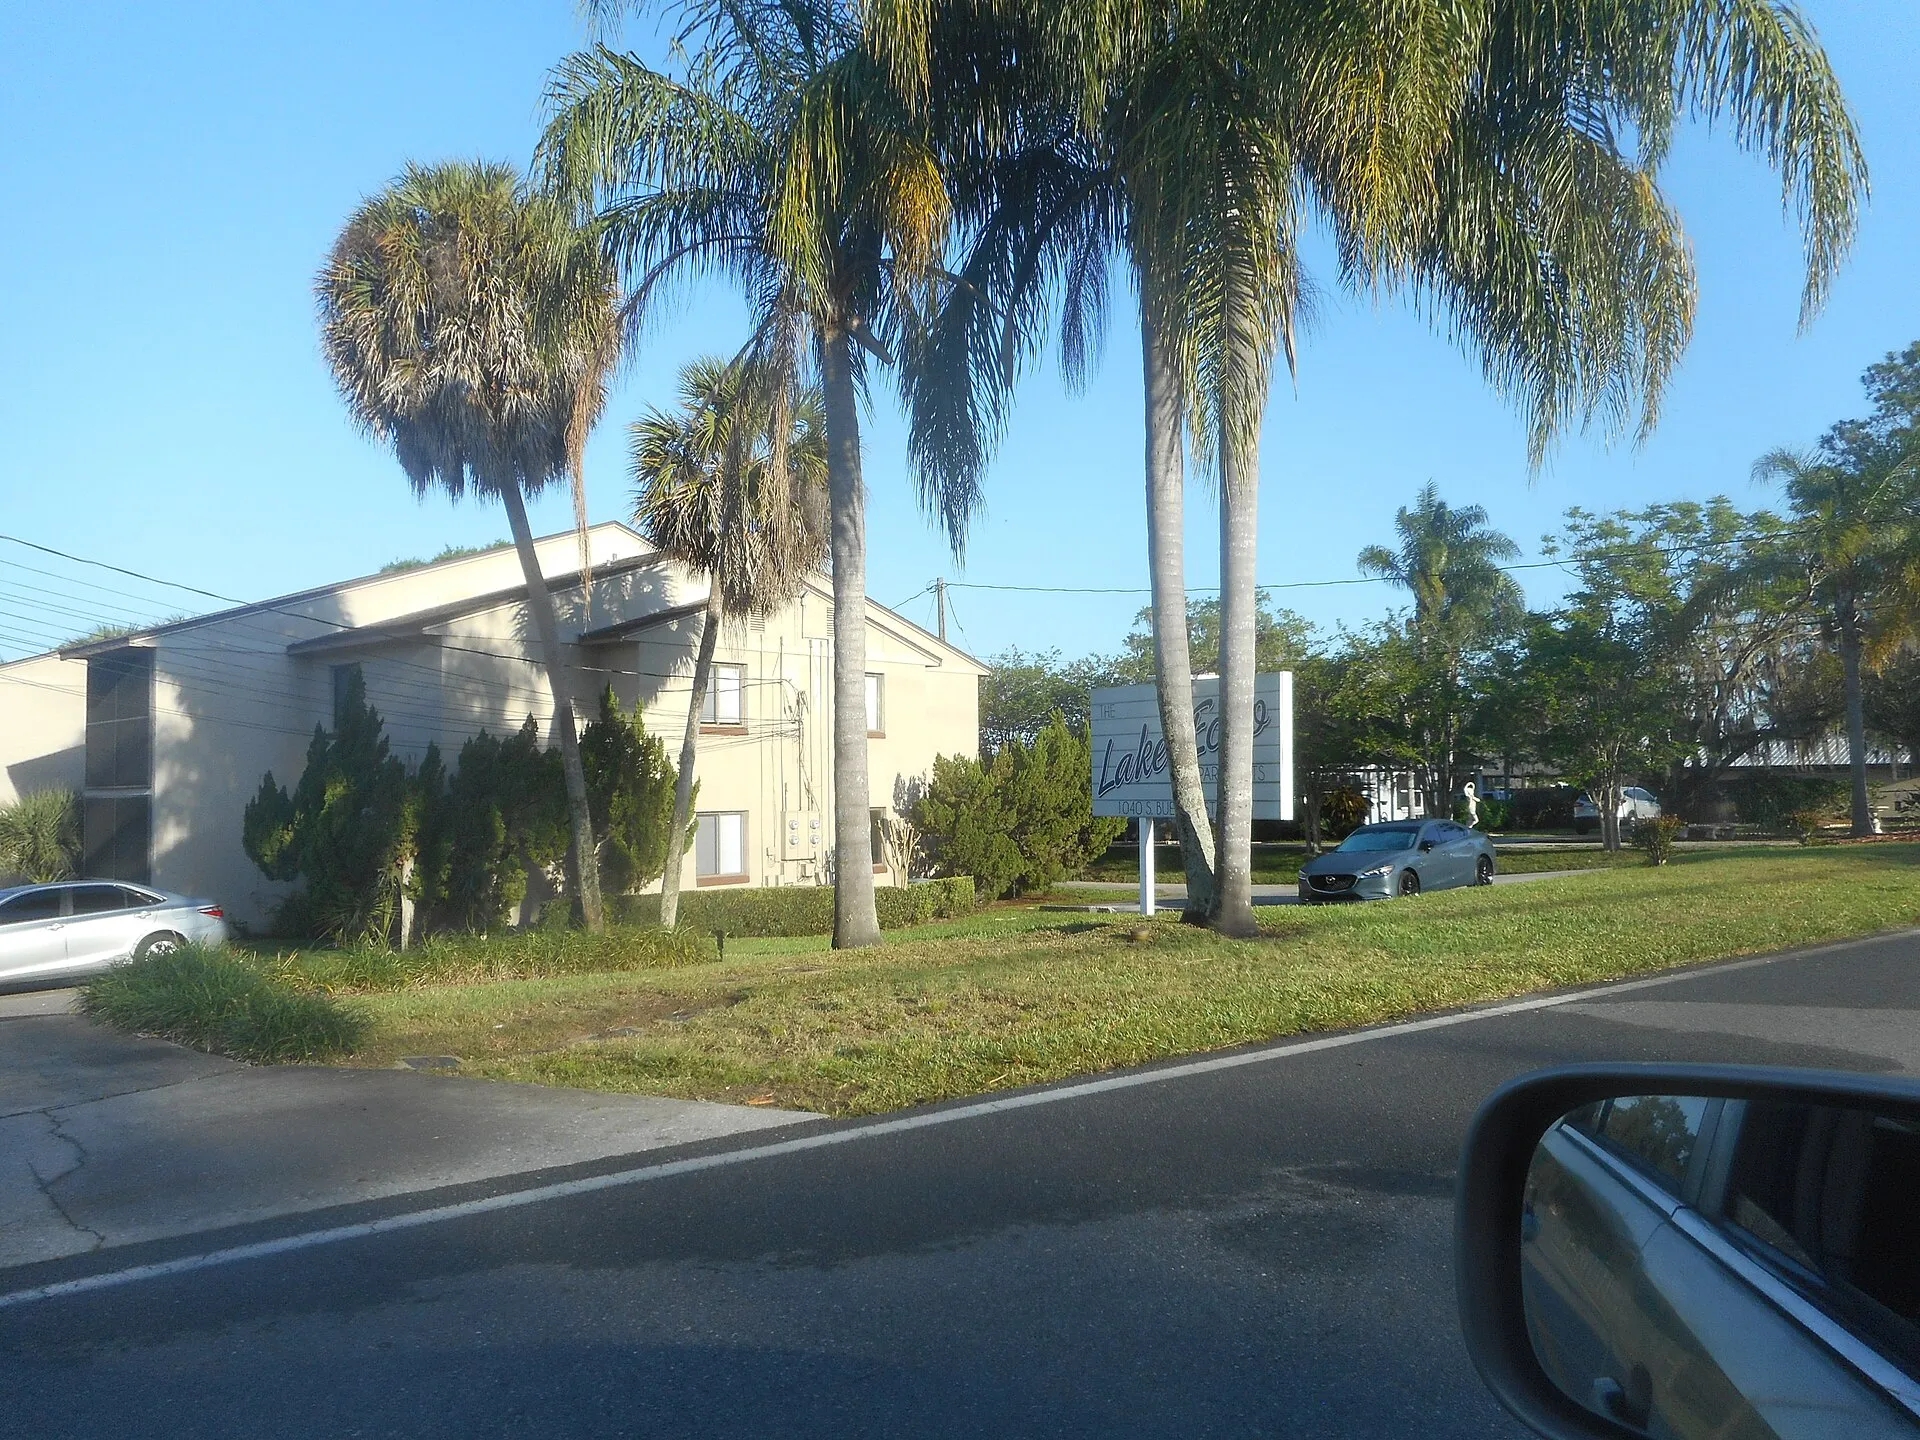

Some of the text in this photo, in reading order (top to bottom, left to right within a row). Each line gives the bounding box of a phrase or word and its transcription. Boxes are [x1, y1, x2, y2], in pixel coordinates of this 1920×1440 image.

[1100, 703, 1116, 719] THE
[1098, 723, 1169, 798] Lake
[1118, 801, 1143, 815] 1040
[1145, 801, 1154, 816] S.
